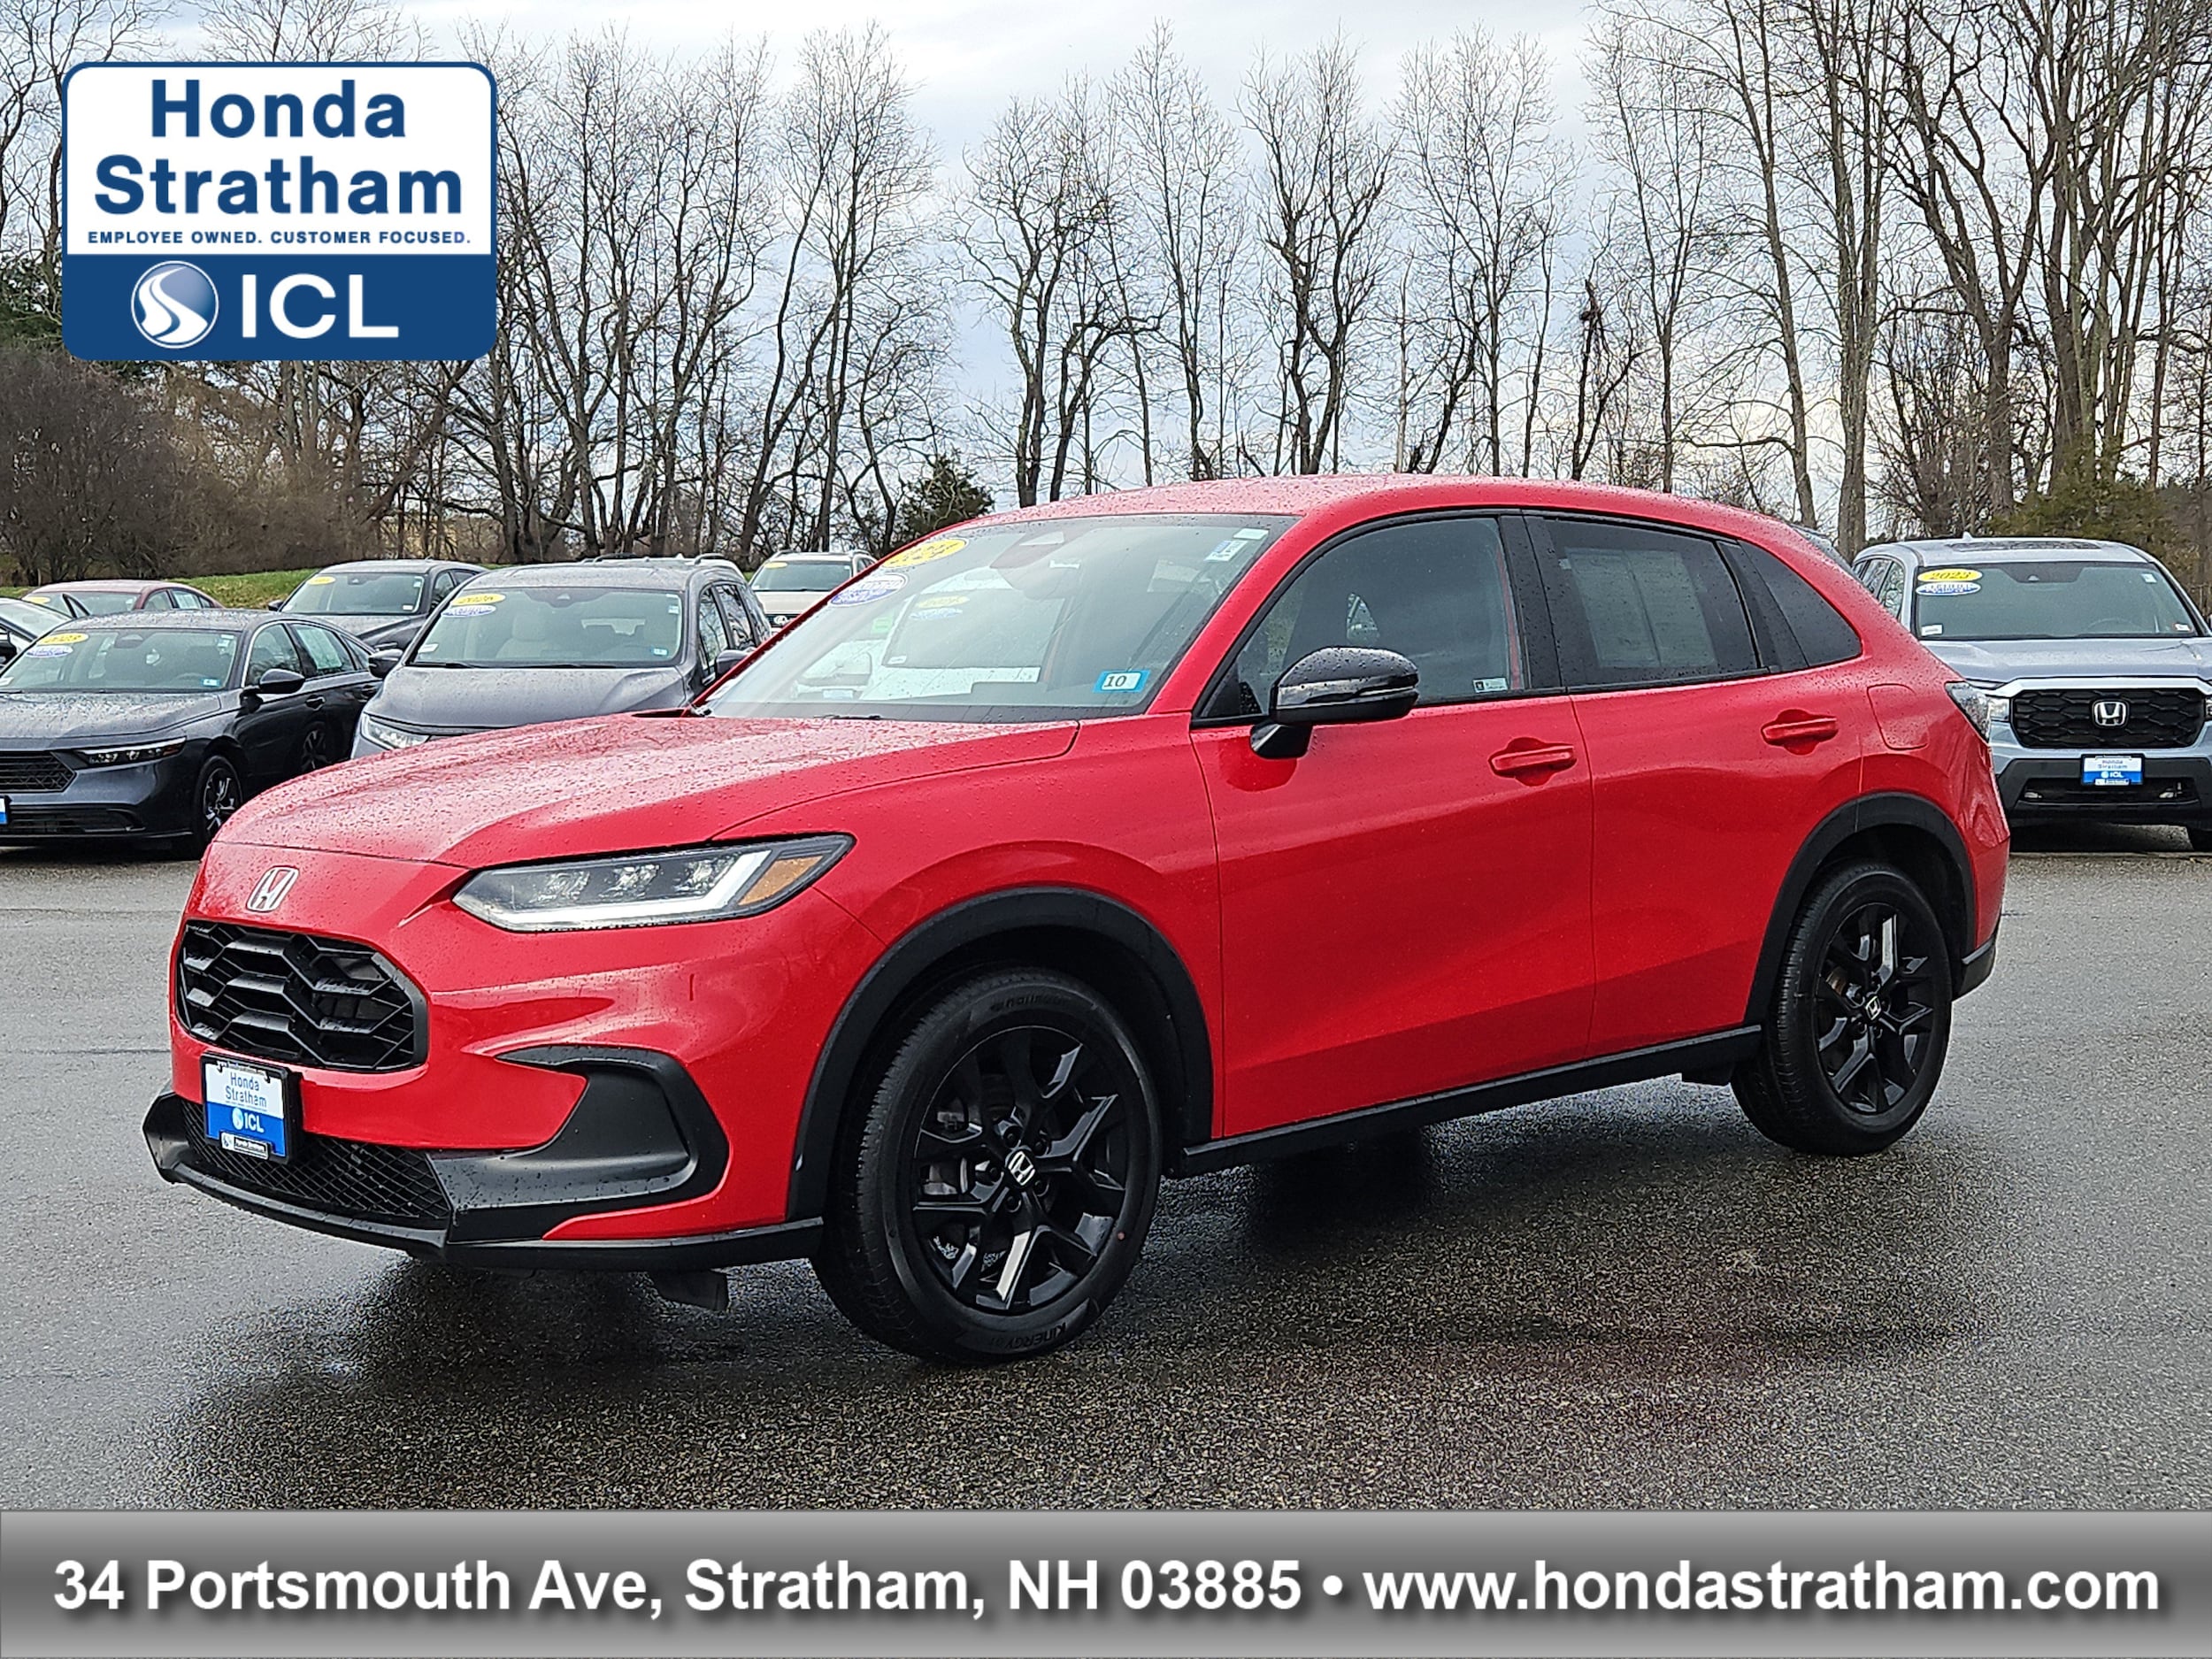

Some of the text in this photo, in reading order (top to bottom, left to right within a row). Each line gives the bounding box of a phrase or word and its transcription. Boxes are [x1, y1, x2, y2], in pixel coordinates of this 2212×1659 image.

[1930, 571, 1972, 580] 2023
[1103, 675, 1127, 687] 10
[230, 1071, 260, 1092] Honda
[225, 1085, 267, 1108] Stratham
[244, 1112, 265, 1133] ICL
